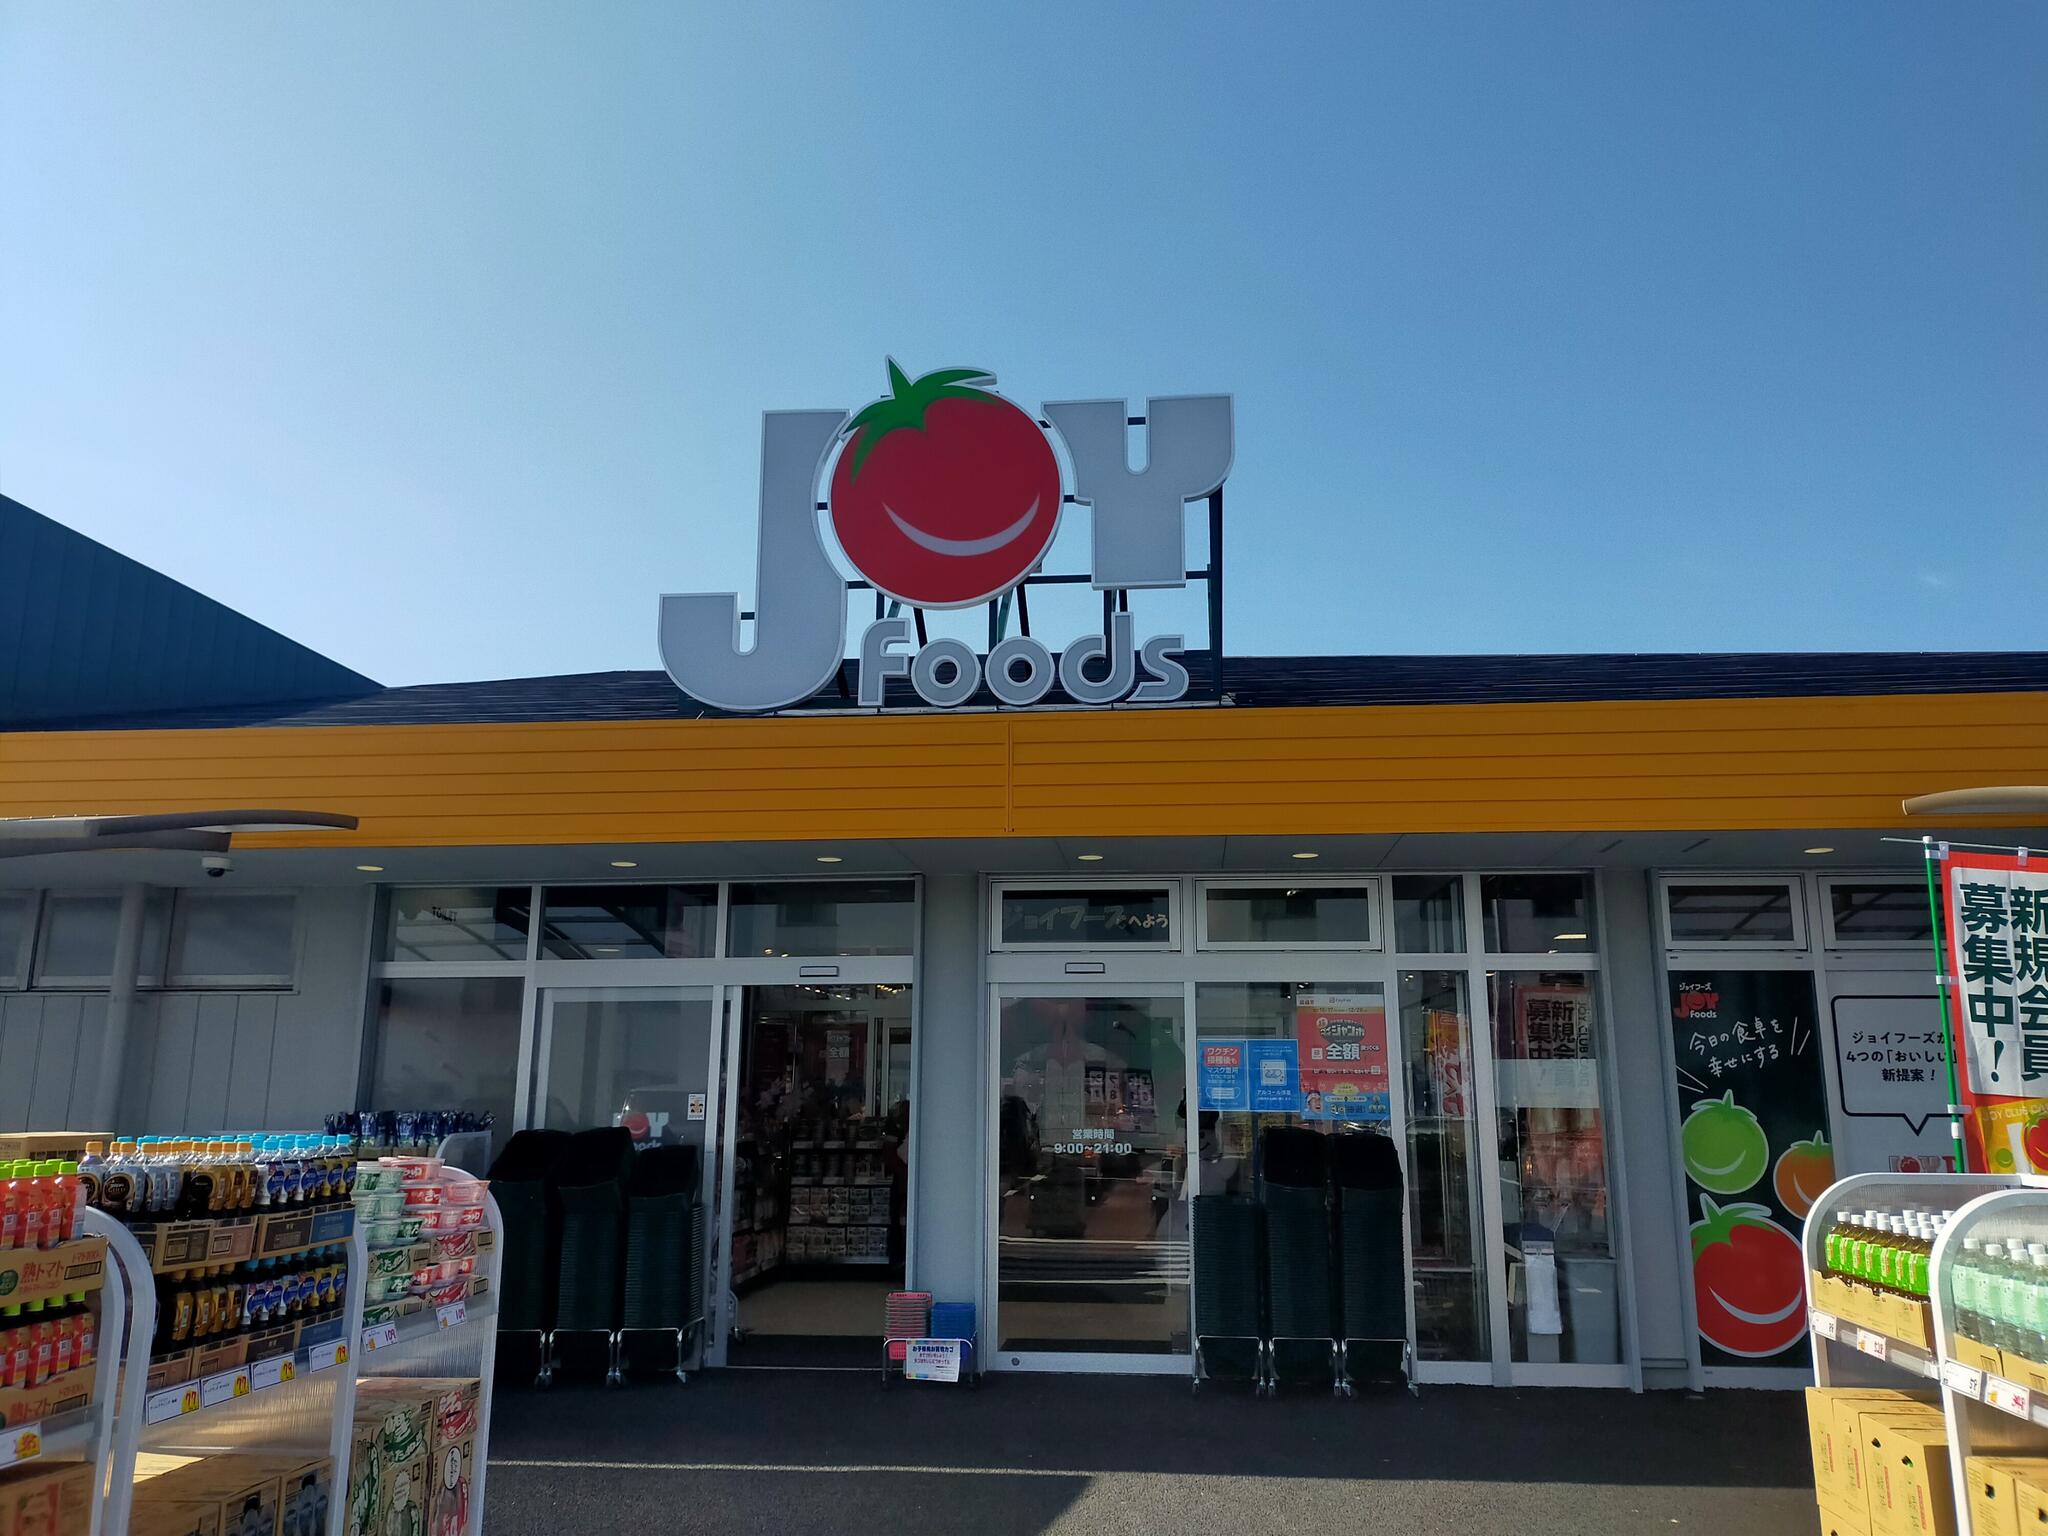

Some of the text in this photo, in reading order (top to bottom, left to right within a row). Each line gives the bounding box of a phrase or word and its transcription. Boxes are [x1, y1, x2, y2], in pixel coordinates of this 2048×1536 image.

[857, 611, 1189, 707] foods
[1960, 882, 2014, 1083] 募集中!
[2009, 886, 2048, 1081] 新規会員
[1207, 1047, 1238, 1056] ワクチン
[1326, 1043, 1361, 1060] 全額
[1689, 1016, 1783, 1056] 今日の食卓を
[1708, 1044, 1779, 1078] 幸せにする
[1072, 1129, 1115, 1139] 営業時間
[384, 1329, 396, 1342] 109
